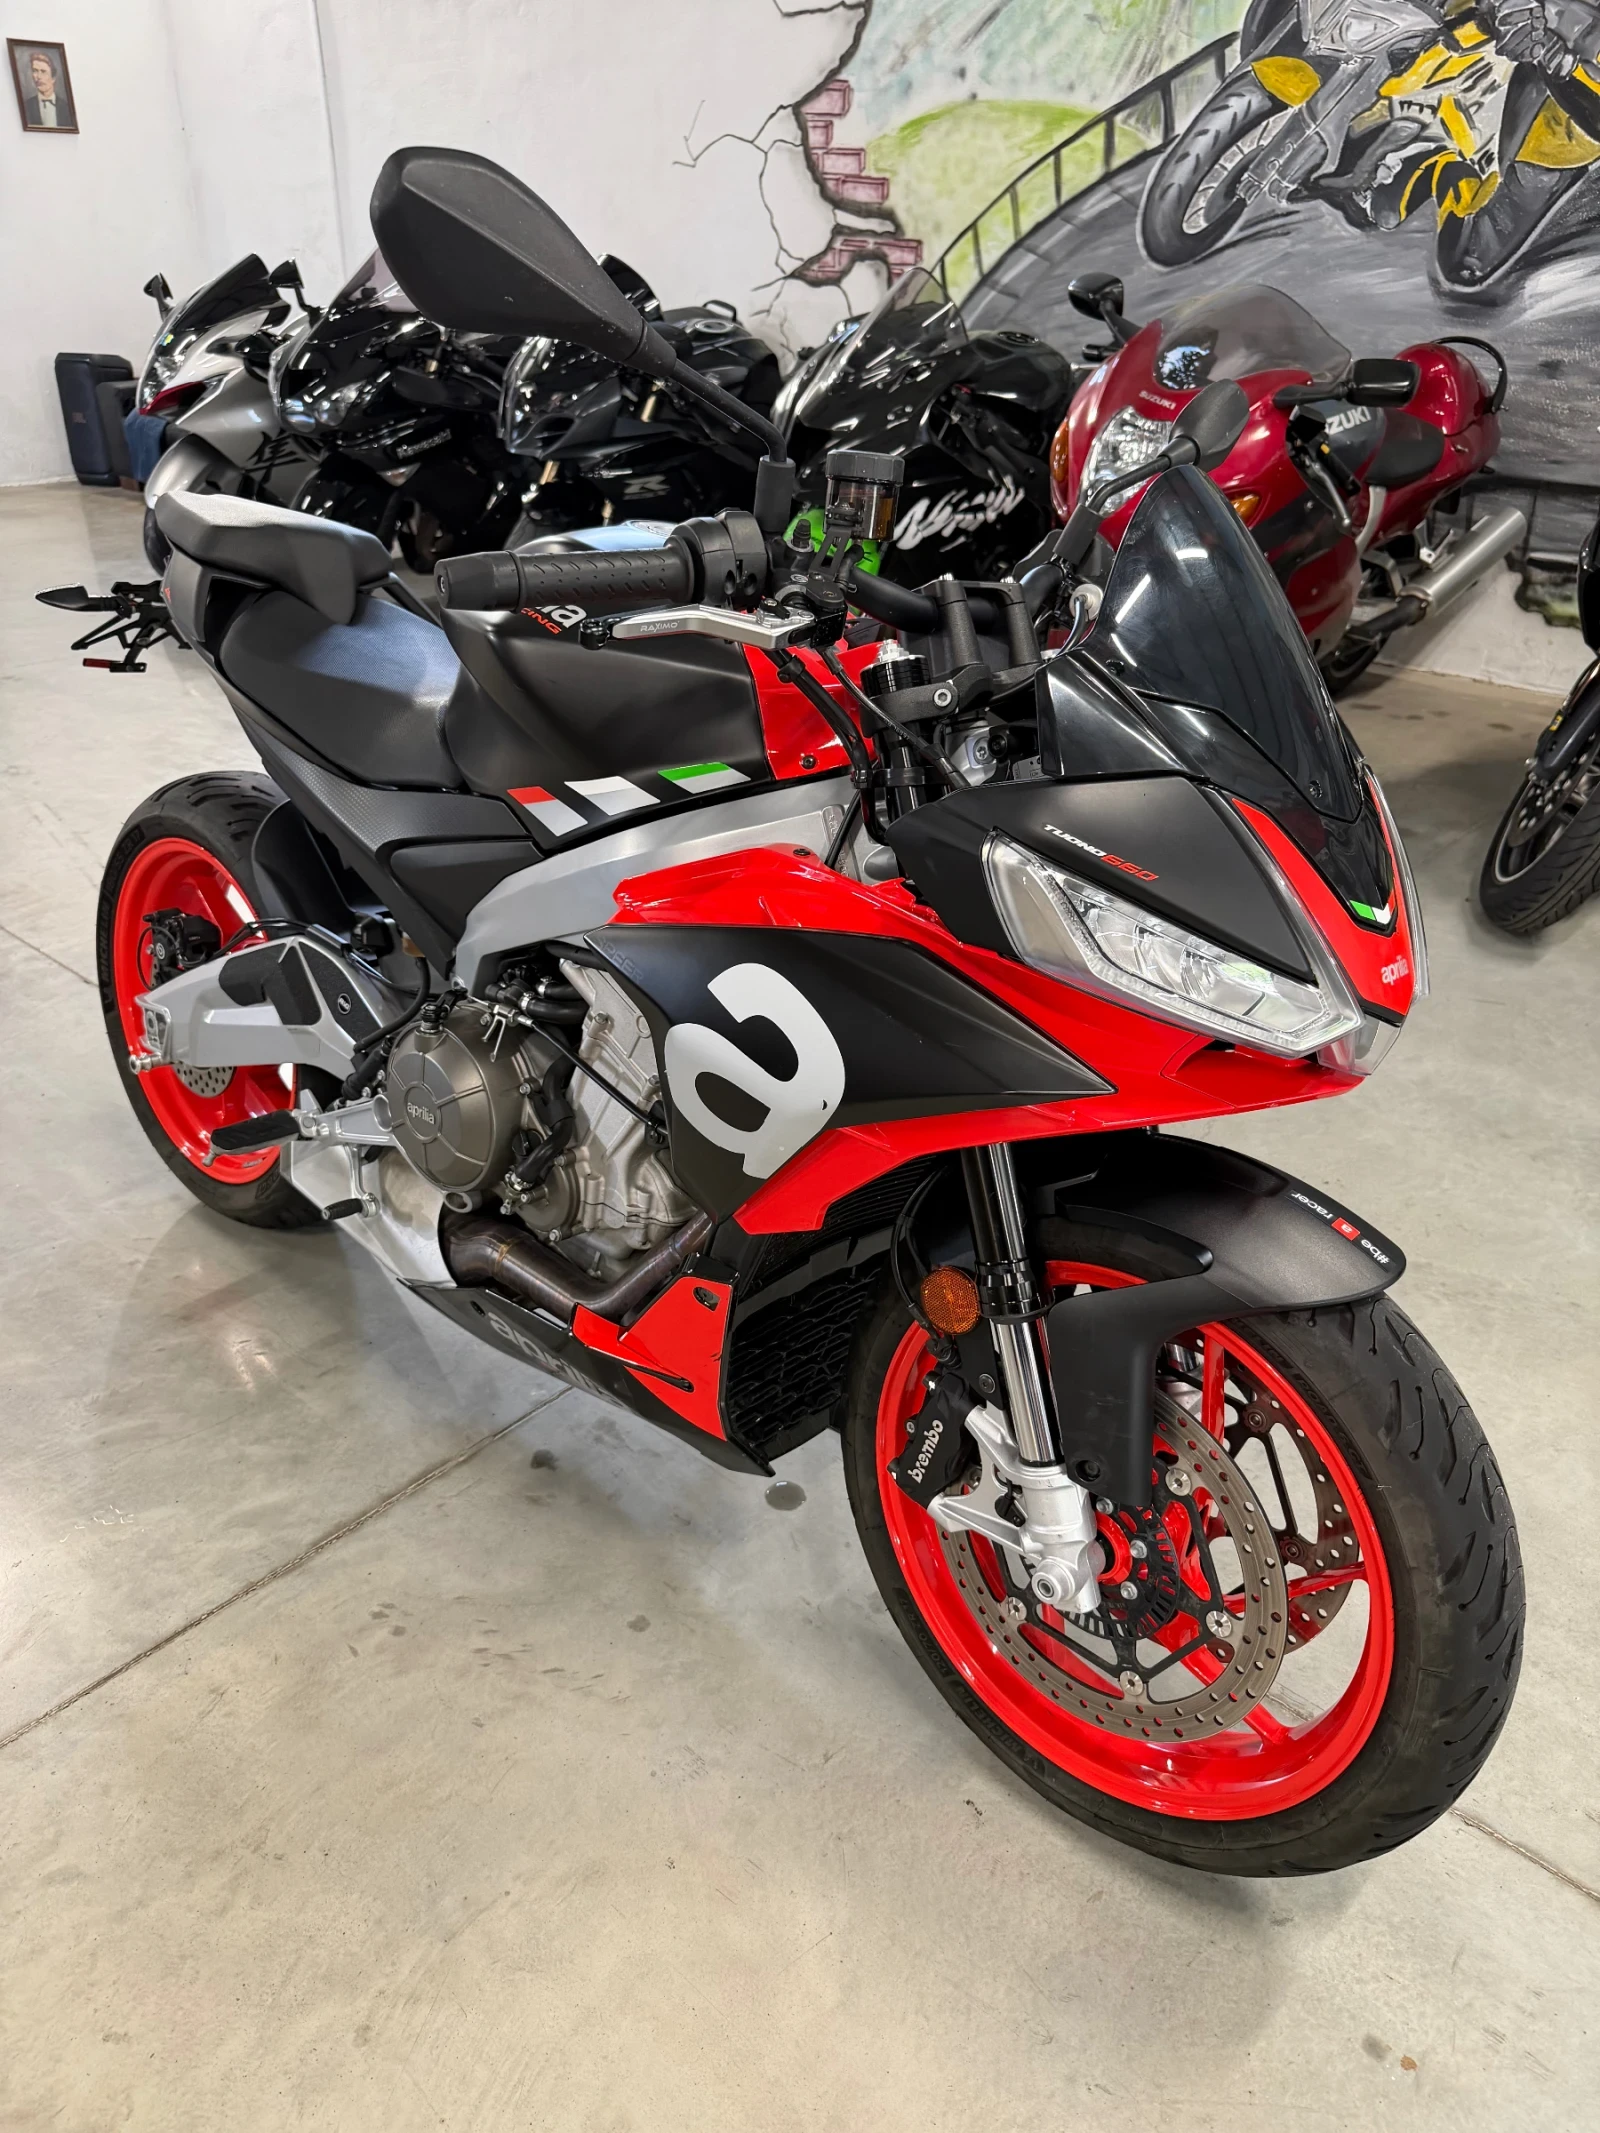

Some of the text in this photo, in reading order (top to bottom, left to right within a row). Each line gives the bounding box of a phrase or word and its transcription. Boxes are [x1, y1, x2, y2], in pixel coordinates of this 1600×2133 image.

[1139, 390, 1176, 410] SUZUKI
[1324, 405, 1372, 436] ZUKI
[640, 621, 679, 633] RAXIMO
[407, 1102, 435, 1125] aprilia
[1290, 1192, 1334, 1219] racer
[1361, 1239, 1390, 1264] #be
[907, 1419, 944, 1484] brembo
[917, 1630, 948, 1673] 120/70
[953, 1685, 1022, 1753] MICHELIN
